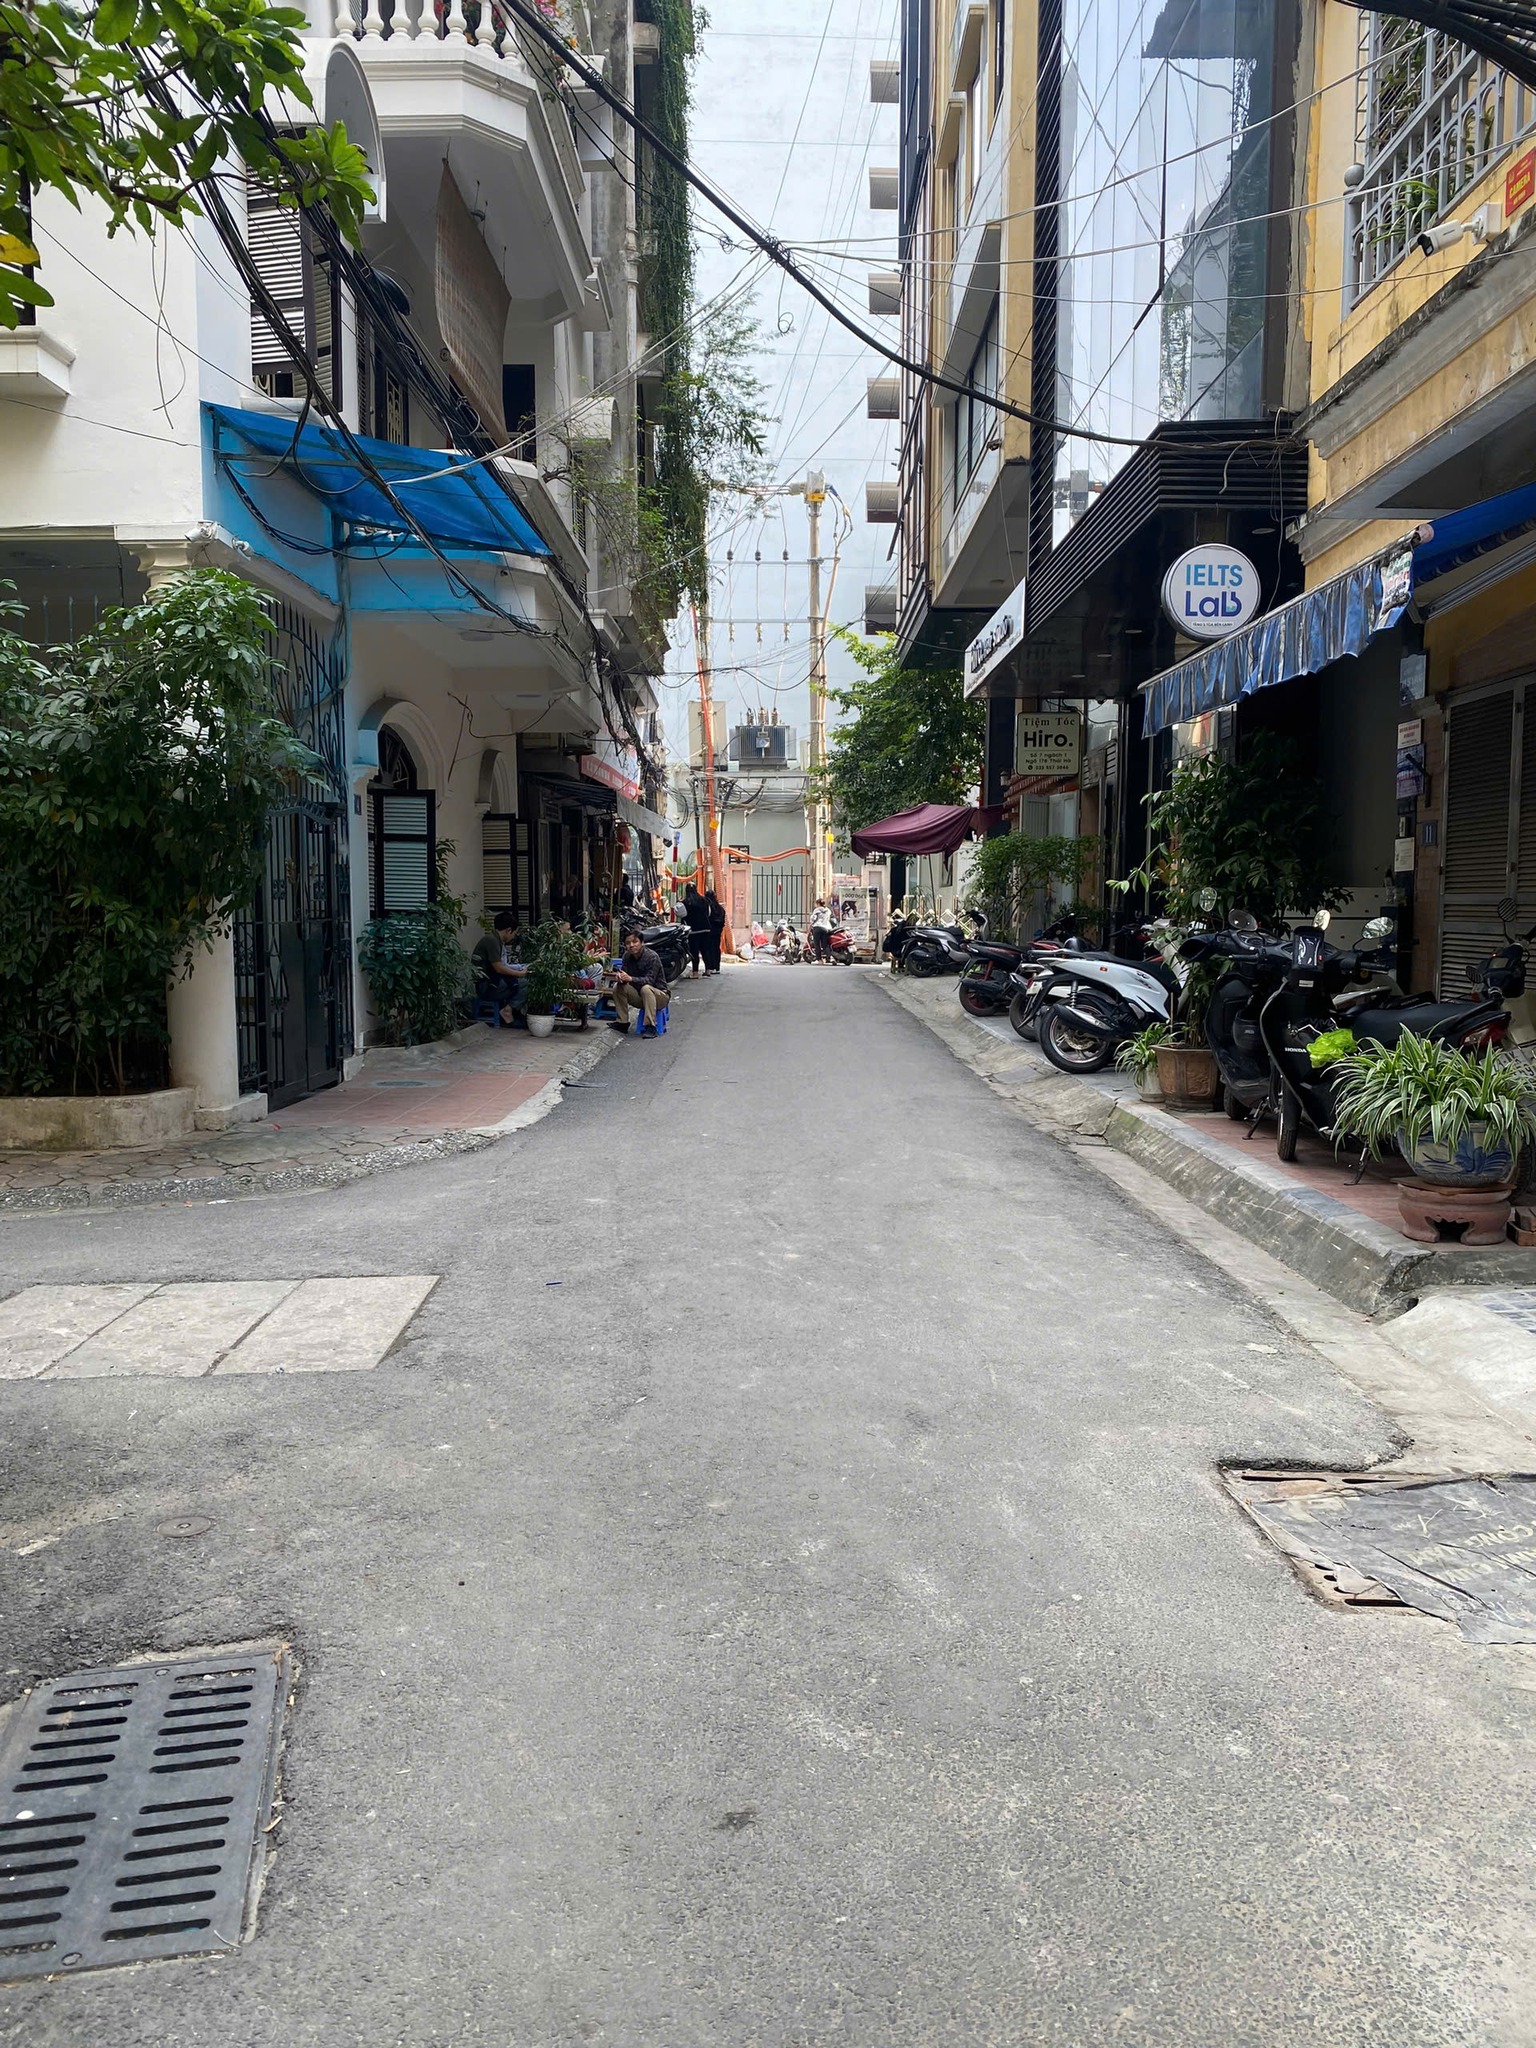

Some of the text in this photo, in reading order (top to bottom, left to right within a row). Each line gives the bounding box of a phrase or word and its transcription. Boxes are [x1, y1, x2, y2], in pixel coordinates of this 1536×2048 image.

[1186, 564, 1243, 587] IELTS
[1185, 590, 1242, 617] Lab
[1023, 716, 1075, 728] Tiệm Tóc
[1024, 730, 1073, 747] Hiro.
